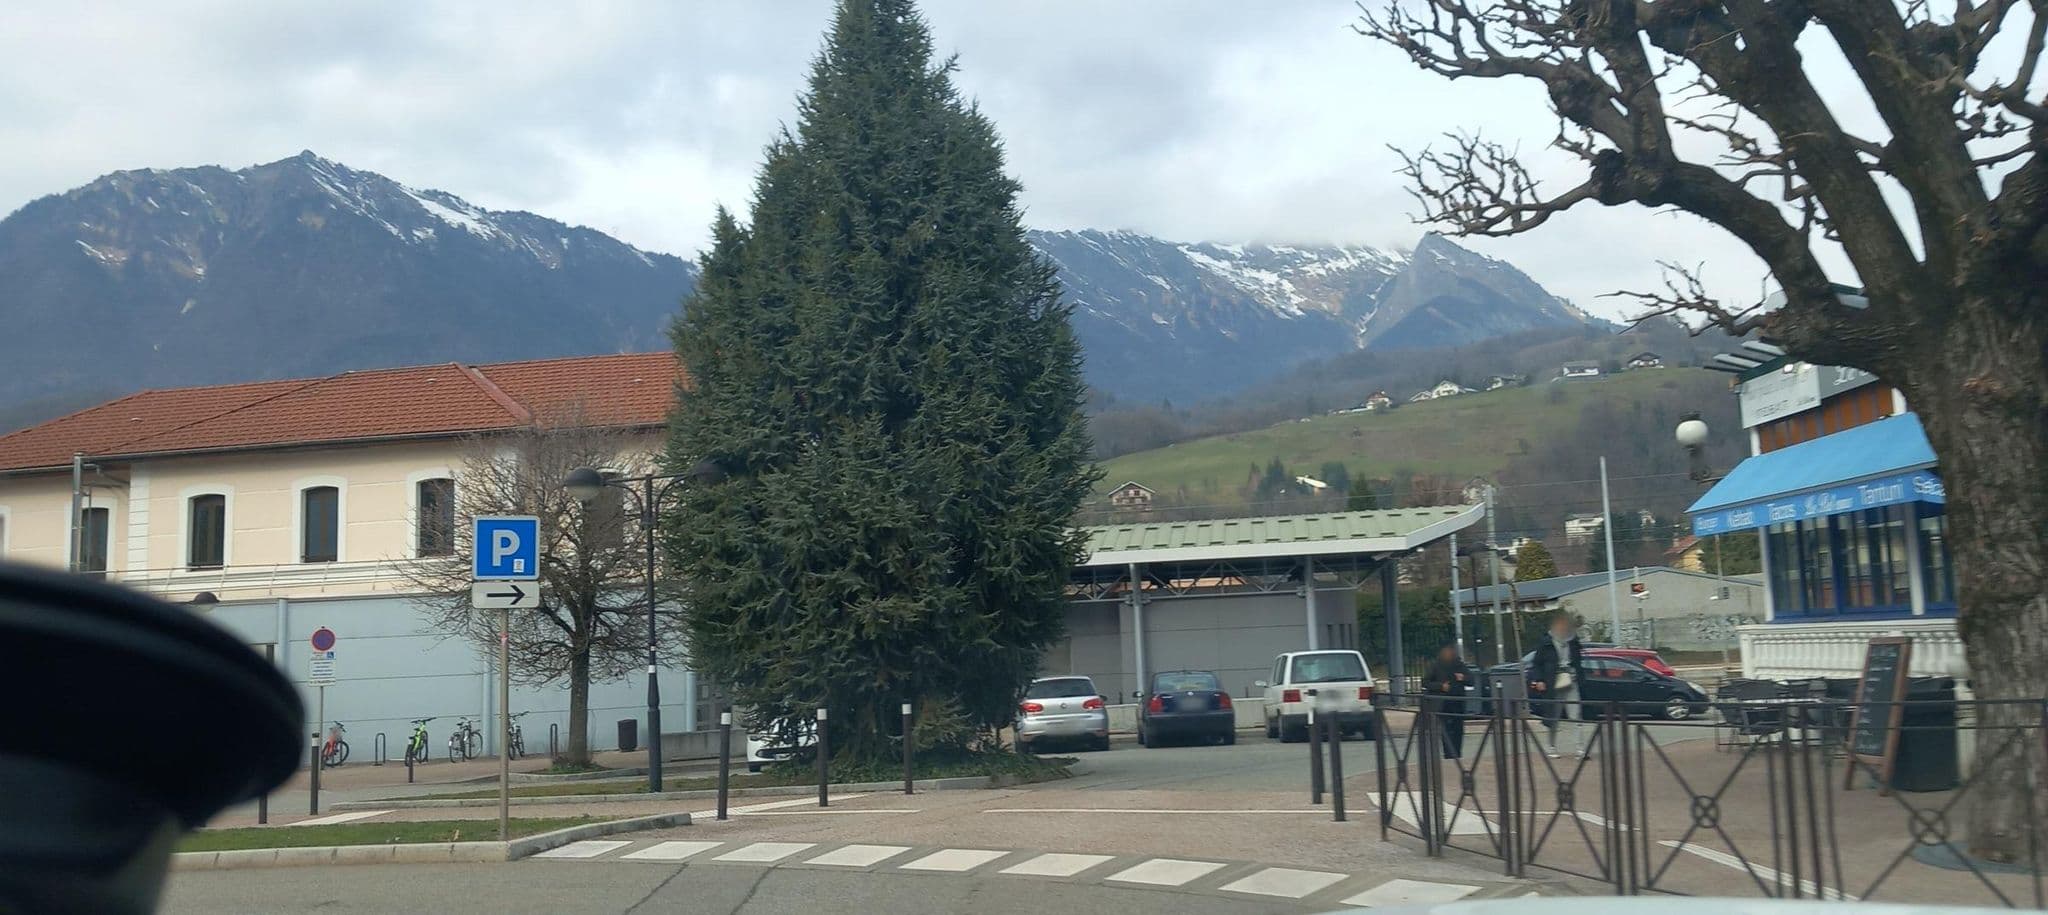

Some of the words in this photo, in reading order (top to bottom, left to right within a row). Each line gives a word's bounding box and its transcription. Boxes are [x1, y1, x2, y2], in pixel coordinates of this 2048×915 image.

[1766, 503, 1796, 521] Tacos
[1857, 479, 1904, 505] Tantuni
[492, 529, 520, 567] P
